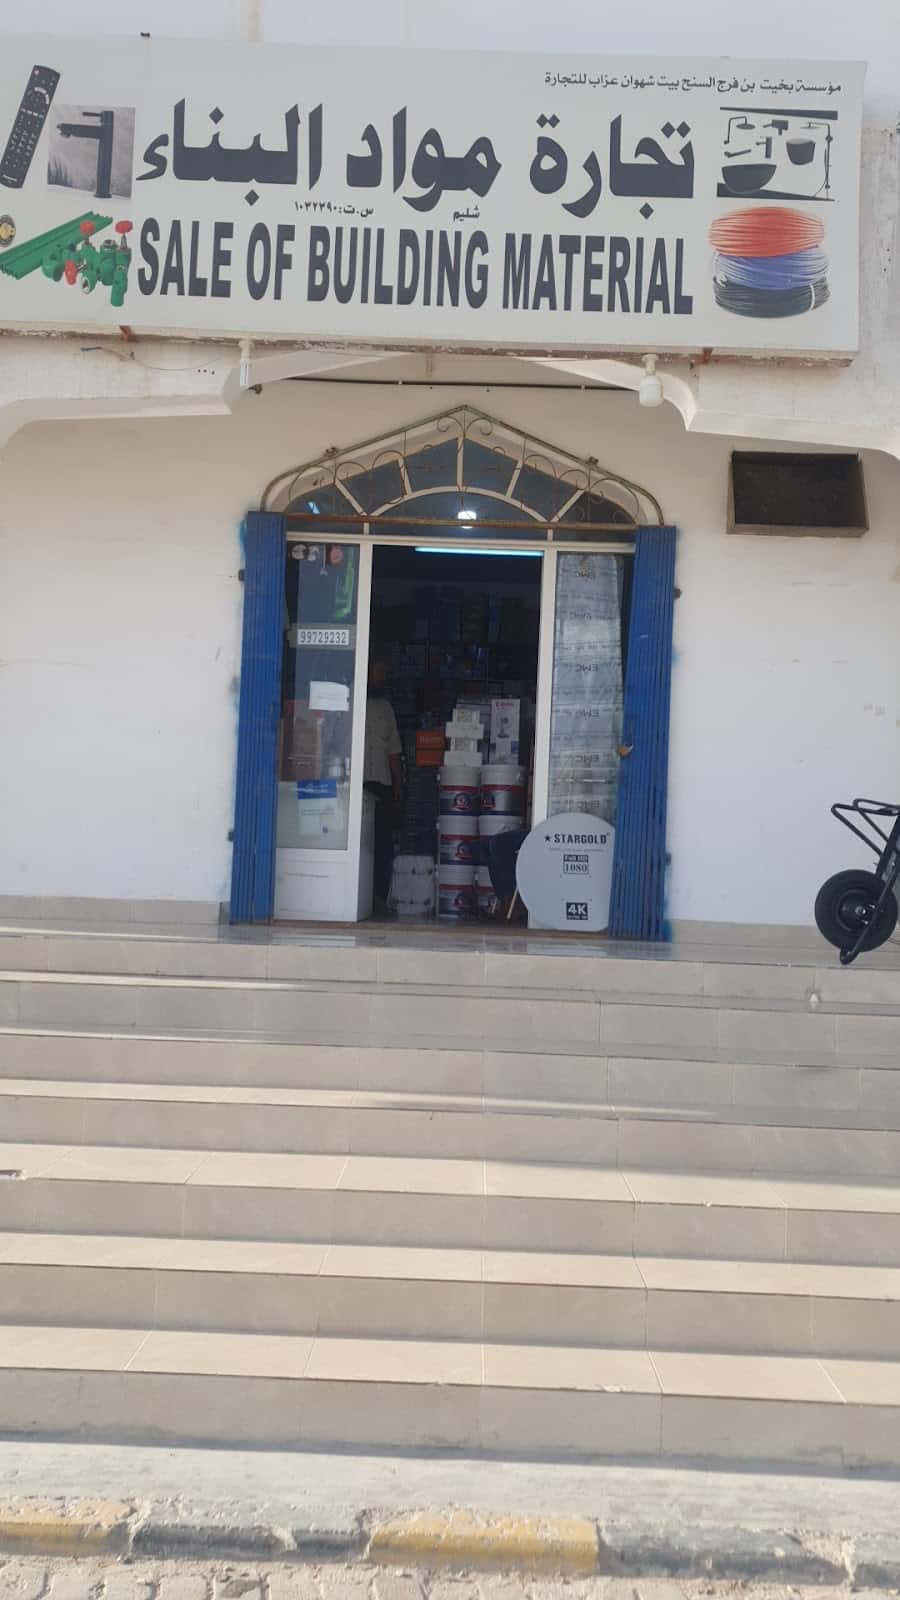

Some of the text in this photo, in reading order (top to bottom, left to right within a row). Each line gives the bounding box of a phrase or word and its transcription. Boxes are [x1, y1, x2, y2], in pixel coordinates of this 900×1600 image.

[545, 71, 587, 87] للتجارة
[590, 74, 618, 88] عزاب
[621, 75, 655, 89] شهوان
[657, 76, 679, 90] بيت
[717, 76, 739, 92] فرج
[740, 78, 755, 93] بن
[760, 79, 794, 94] بخيت
[796, 79, 841, 95] مؤسسة
[136, 98, 694, 219] تجارة مواد البناء
[453, 204, 480, 221] شليم
[138, 218, 693, 314] SALE OF BUILDING MATERIAL
[300, 631, 347, 644] 99729232
[554, 833, 607, 844] STARGOLD
[565, 863, 588, 873] 1080
[567, 903, 587, 914] 4K
